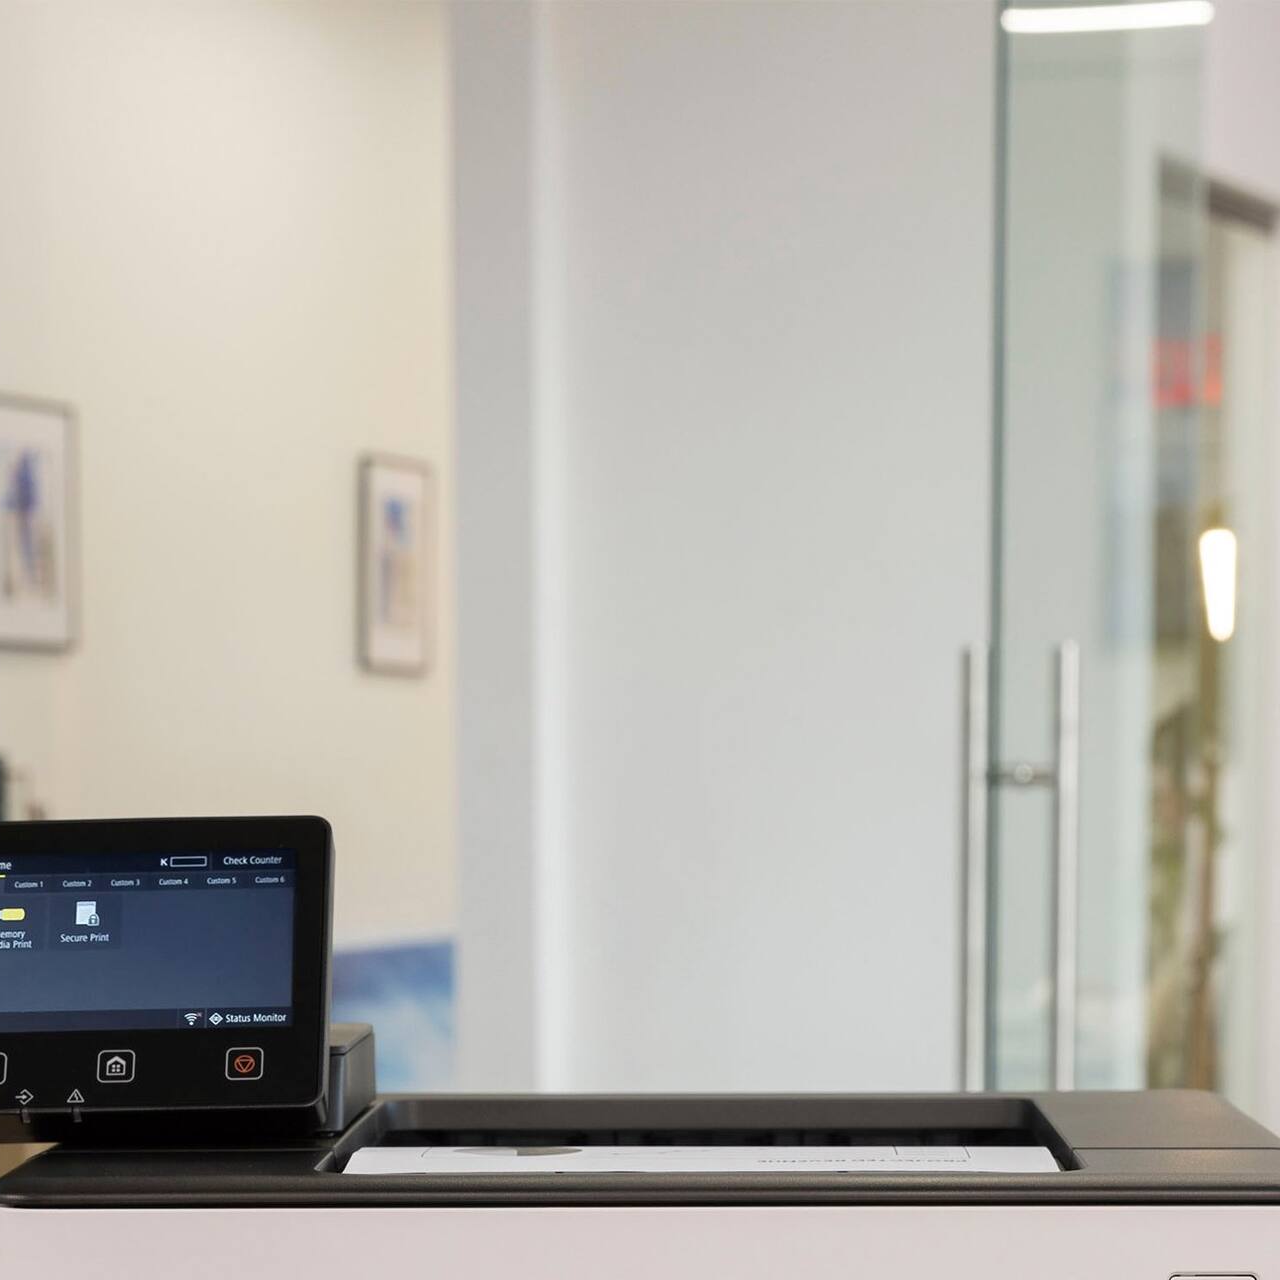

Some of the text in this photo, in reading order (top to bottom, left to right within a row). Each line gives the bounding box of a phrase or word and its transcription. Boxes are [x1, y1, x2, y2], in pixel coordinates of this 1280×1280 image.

[160, 858, 169, 867] K
[223, 855, 282, 865] Check Counter
[62, 880, 86, 888] Custom
[110, 879, 134, 887] Custom
[158, 878, 182, 886] Custom
[207, 877, 231, 885] Custom
[255, 876, 279, 884] Custom
[14, 881, 38, 889] Custom
[60, 933, 110, 943] Secure Print
[13, 940, 32, 949] Print
[225, 1013, 287, 1024] Status Monitor
